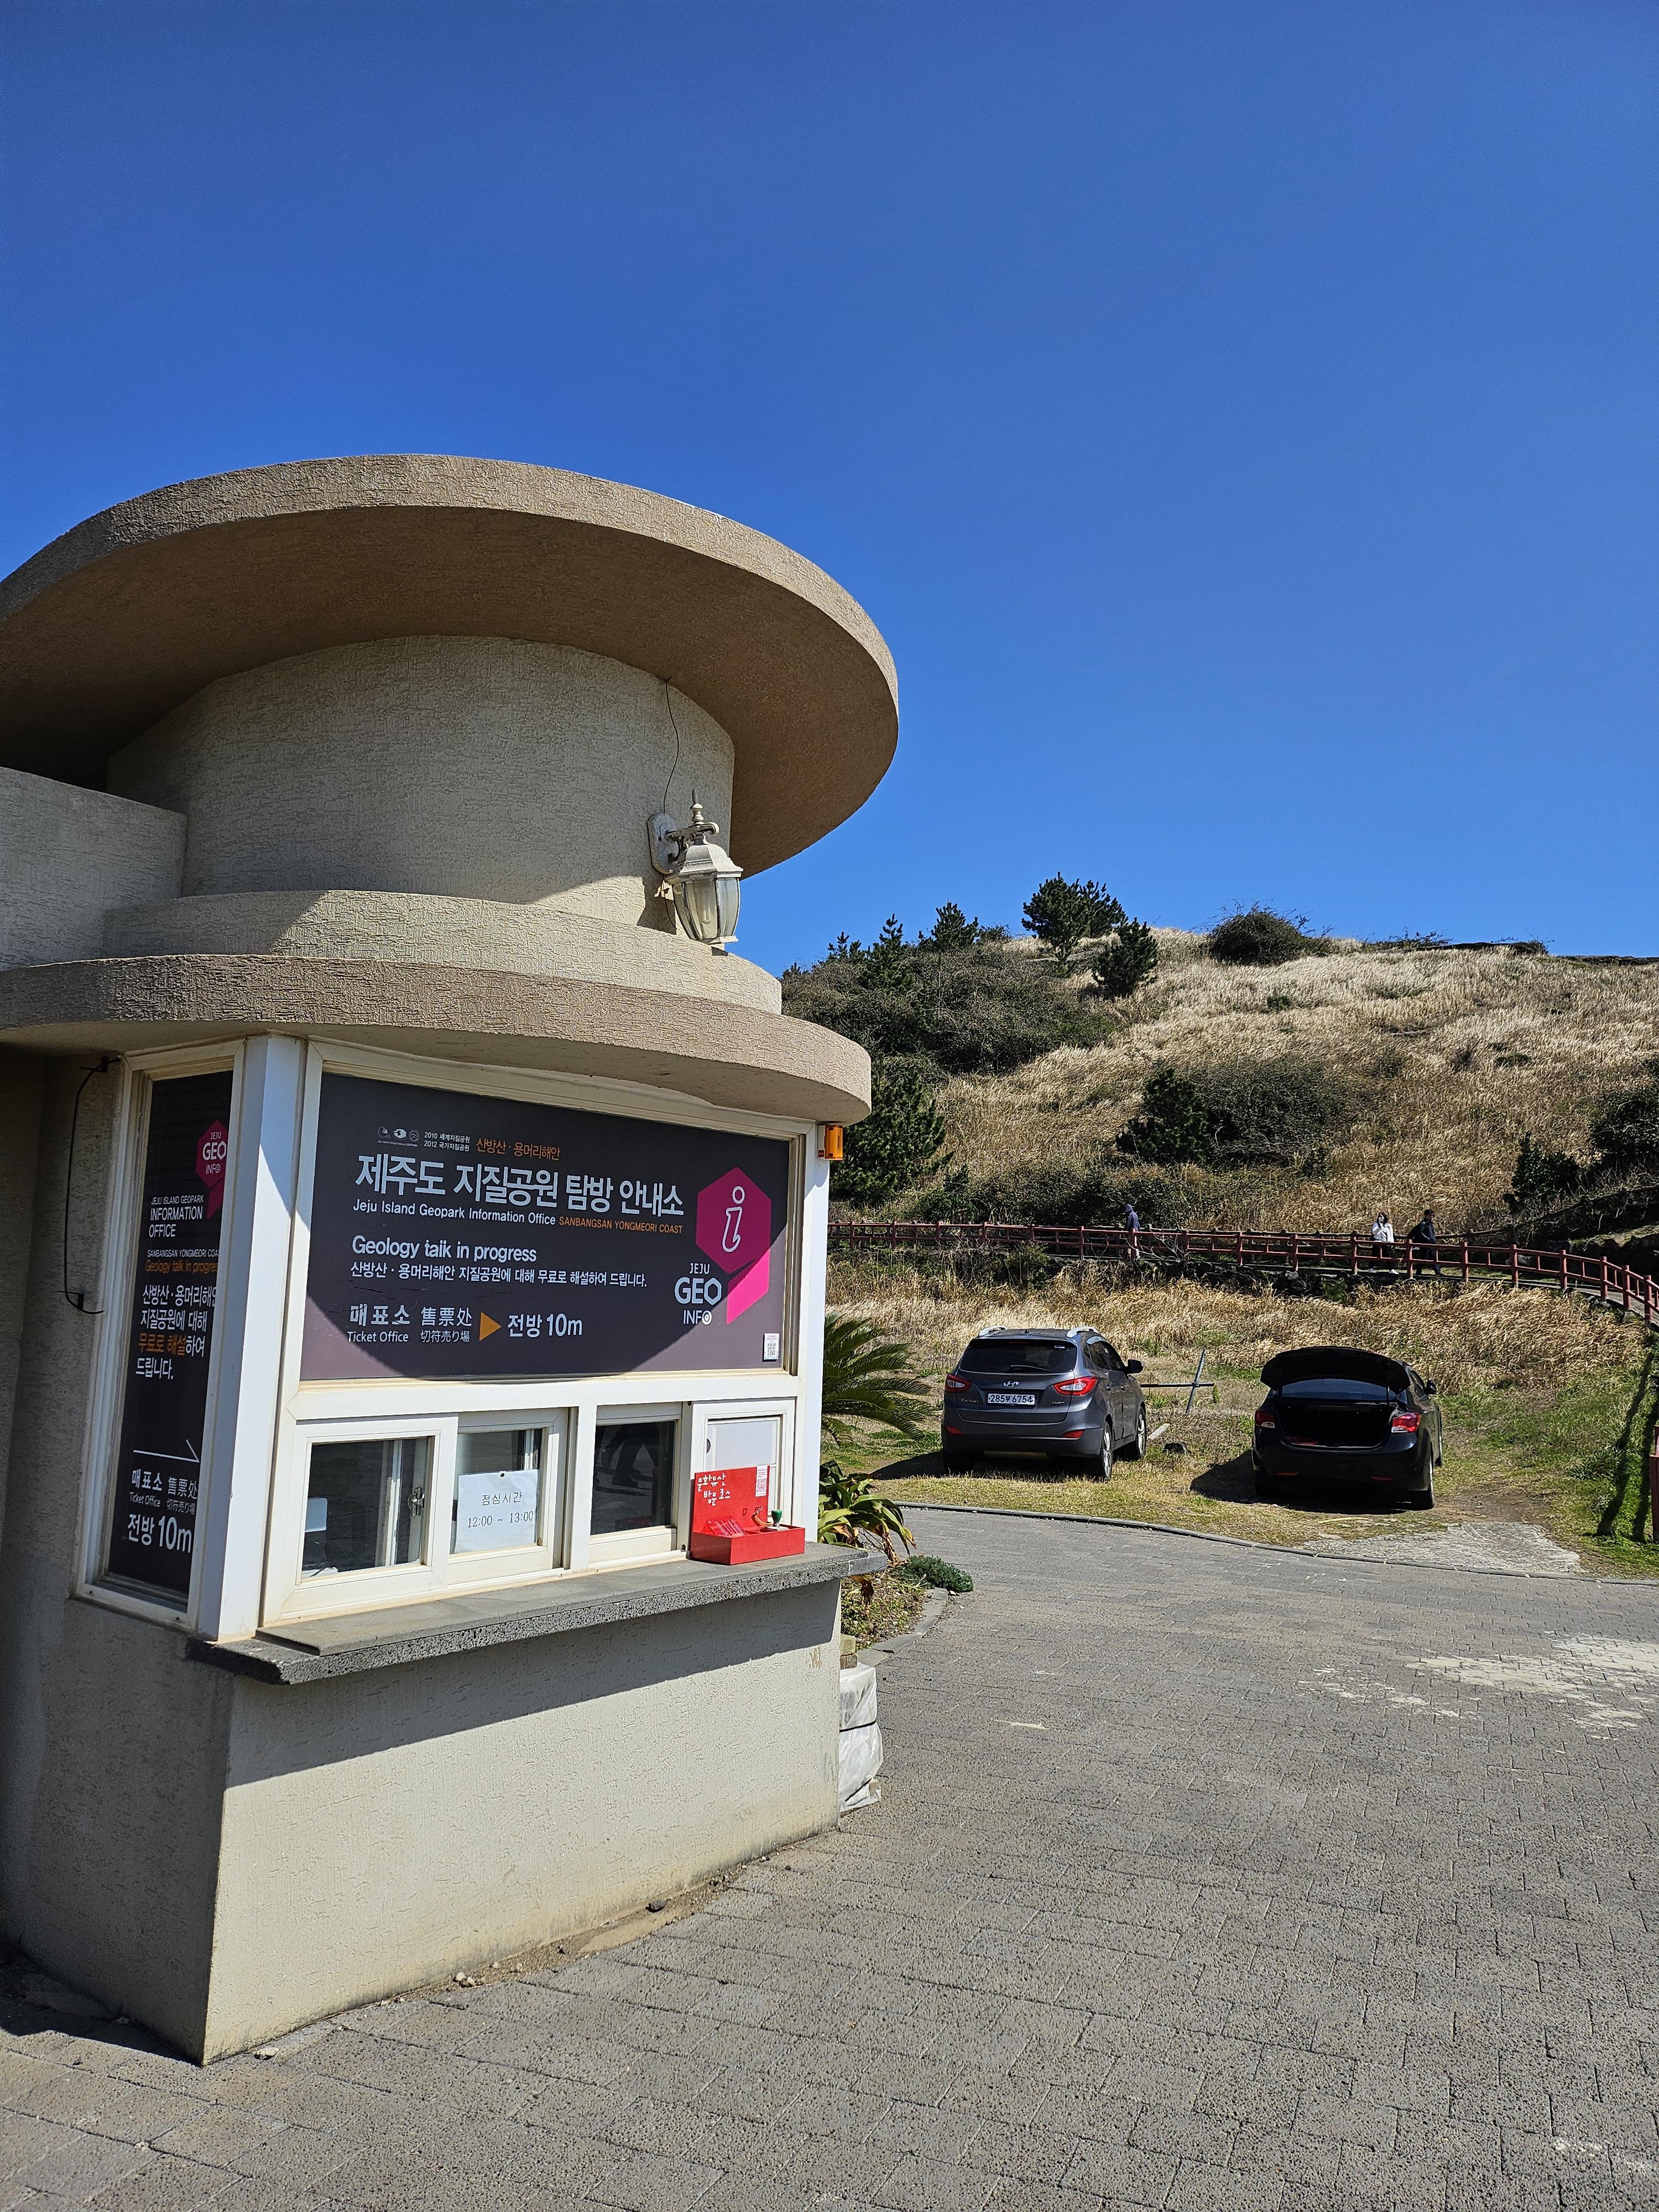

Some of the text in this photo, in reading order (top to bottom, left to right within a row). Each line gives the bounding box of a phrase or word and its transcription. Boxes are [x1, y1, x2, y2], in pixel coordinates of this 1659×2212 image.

[211, 1131, 221, 1140] JEJU
[202, 1141, 227, 1161] GEO
[476, 1138, 507, 1155] 산방산
[513, 1142, 561, 1161] 용머리해안
[206, 1164, 221, 1174] INFO
[355, 1154, 684, 1217] 제주도 지질공원 탐방 안내소
[163, 1196, 180, 1204] ISLAND
[181, 1194, 204, 1204] GEOPARK
[150, 1206, 203, 1220] INFORMATION
[353, 1198, 683, 1234] Jeju Island Geopark Information Office SANBANGSAN YONGMEORI COAST
[149, 1224, 176, 1238] OFFICE
[147, 1249, 219, 1258] SANBANGSAN YONGMEORI COA
[352, 1235, 420, 1259] Geology
[456, 1241, 469, 1259] in
[473, 1245, 537, 1263] progress
[350, 1261, 388, 1278] 산방산
[398, 1263, 456, 1281] 용머리해안
[458, 1266, 512, 1282] 지질공원에
[515, 1268, 535, 1284] 대해
[538, 1270, 567, 1284] 무료로
[570, 1271, 607, 1286] 해설하여
[609, 1272, 647, 1287] 드립니다.
[690, 1262, 710, 1275] JEJU
[142, 1284, 169, 1306] 산방산
[675, 1277, 722, 1305] GEO
[140, 1308, 208, 1332] 지질공원에 대해
[349, 1303, 472, 1327] 매표소 售票处
[507, 1313, 583, 1338] 전방 10m
[683, 1310, 712, 1325] INFO
[138, 1332, 205, 1358] 무료로 해설하여
[347, 1329, 470, 1343] Ticket Office 切符売り場
[135, 1357, 174, 1379] 드립니다.
[132, 1468, 198, 1500] 매표소 售票处
[697, 1472, 726, 1492] 문화유산
[129, 1491, 145, 1505] Ticket
[145, 1495, 161, 1508] Office
[482, 1491, 522, 1506] 점심시간
[468, 1515, 492, 1528] 12:00
[509, 1511, 534, 1523] 13:00
[127, 1514, 192, 1553] 전방 10m
